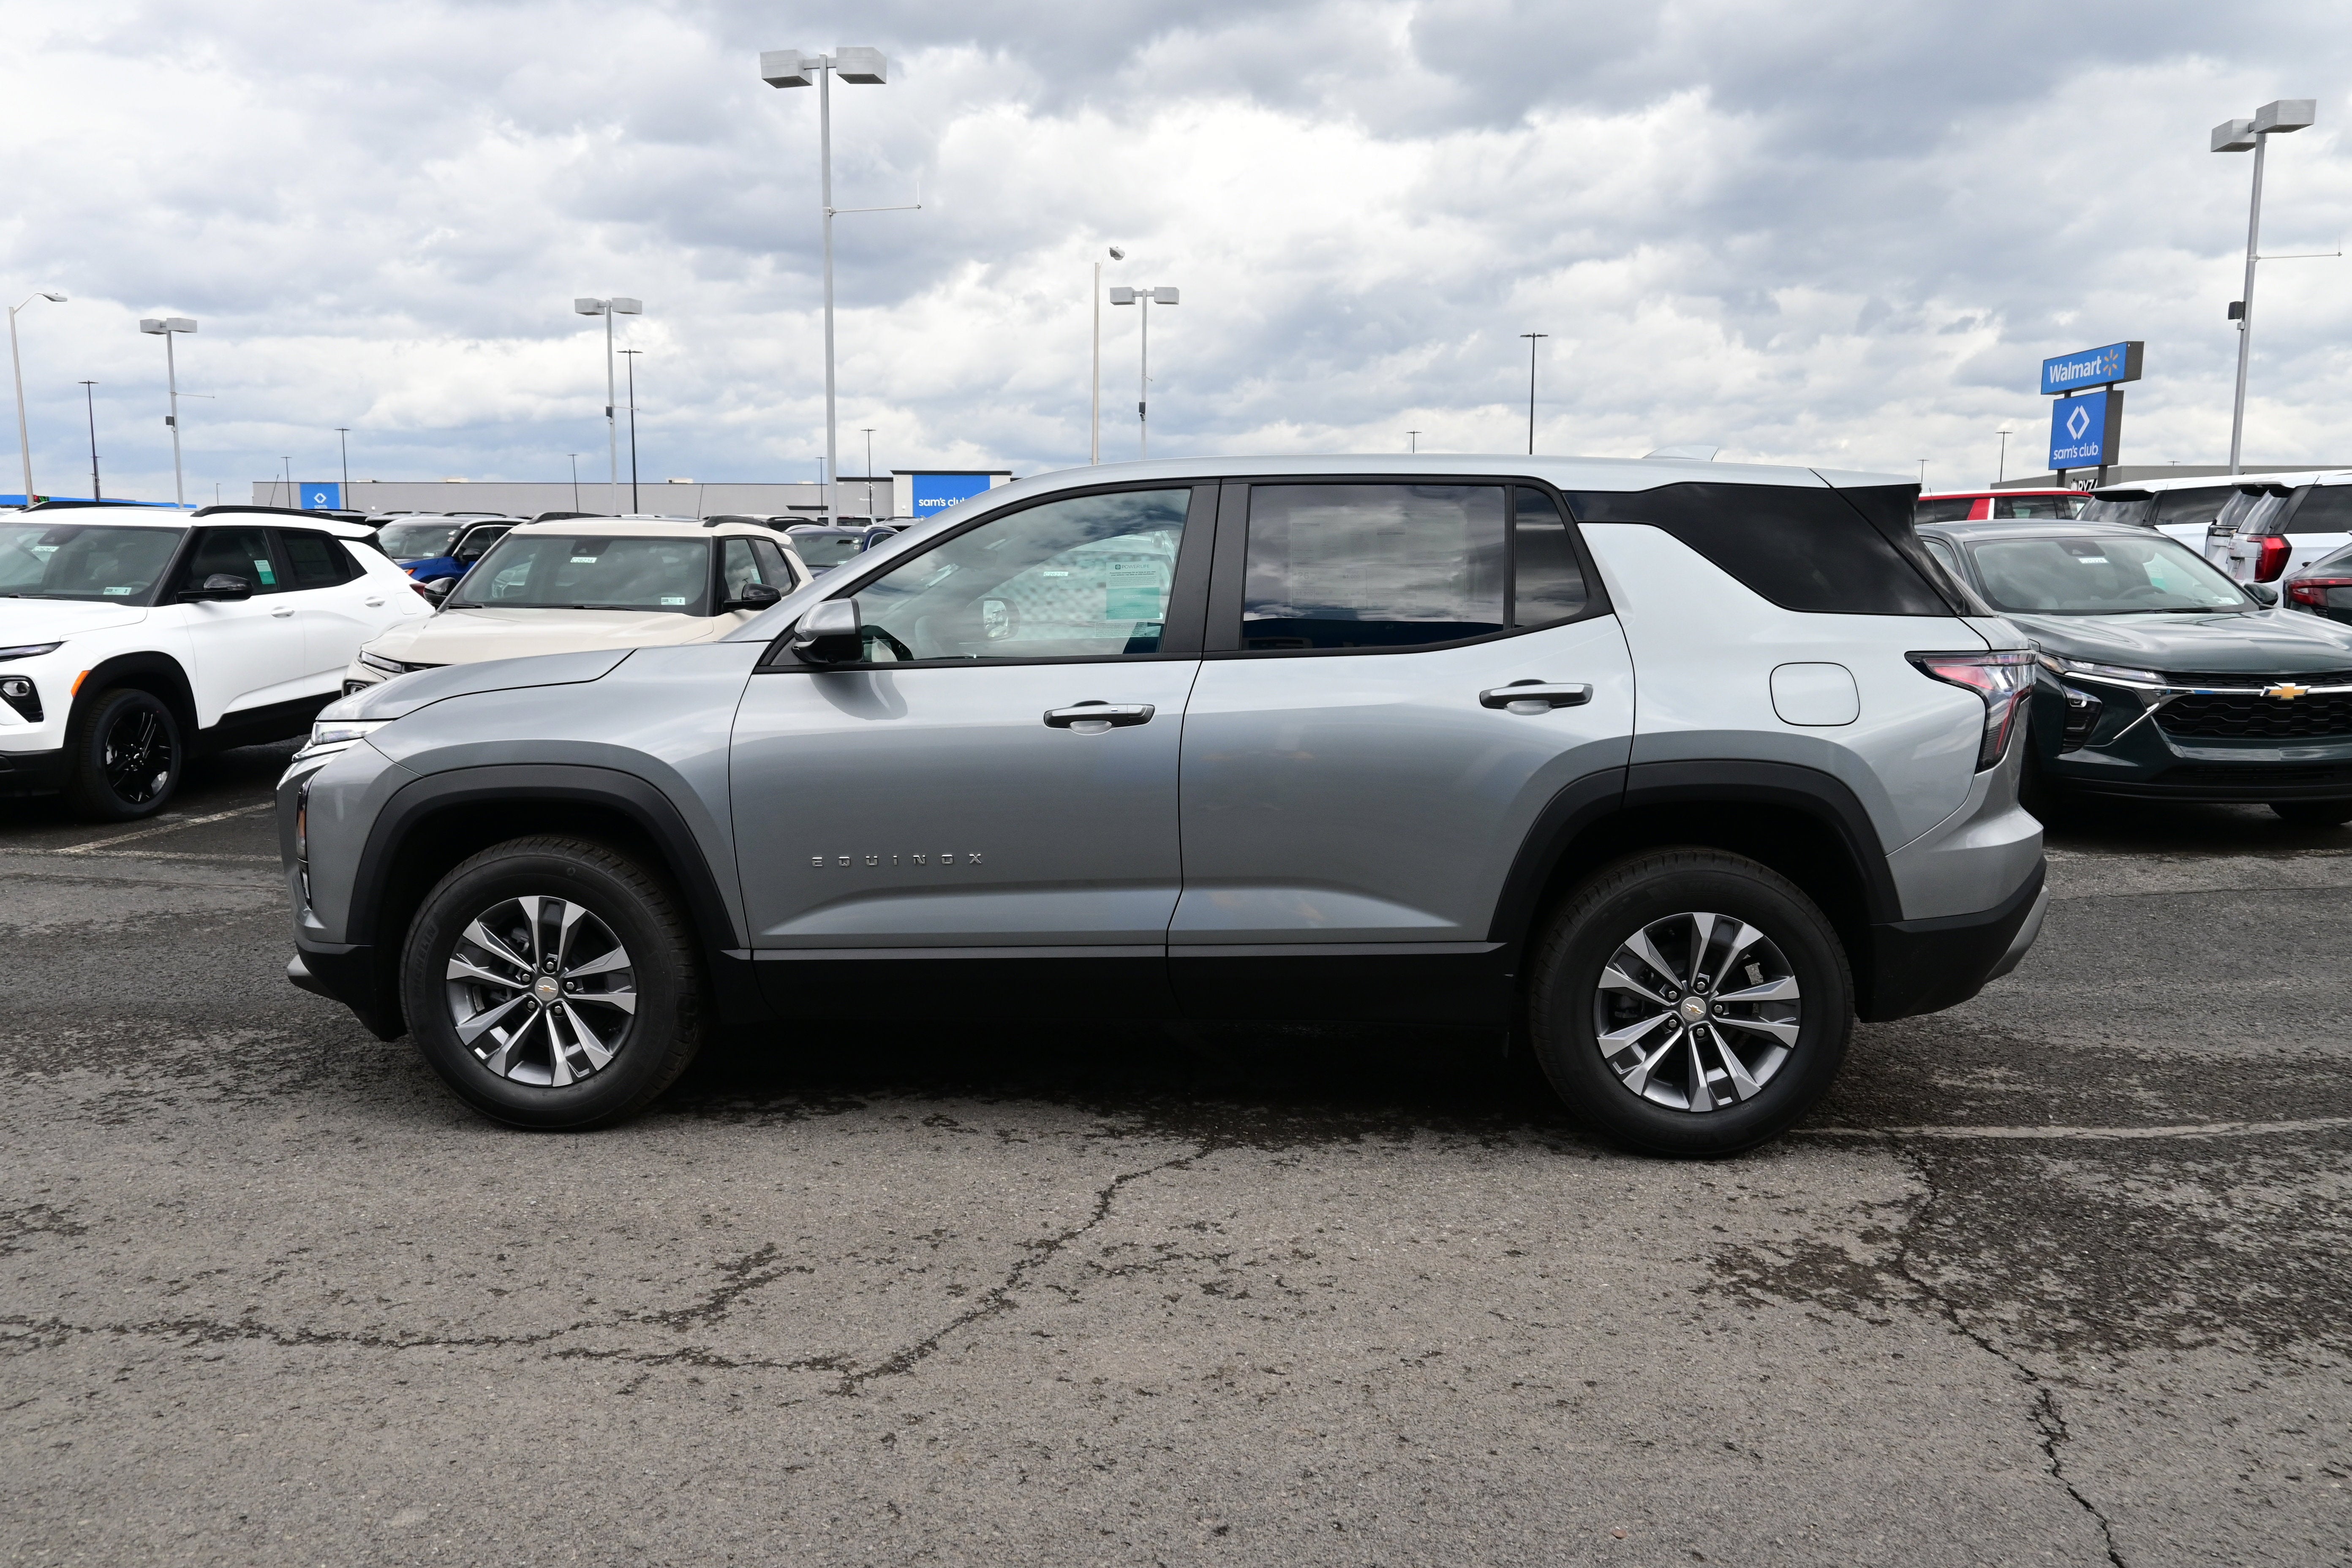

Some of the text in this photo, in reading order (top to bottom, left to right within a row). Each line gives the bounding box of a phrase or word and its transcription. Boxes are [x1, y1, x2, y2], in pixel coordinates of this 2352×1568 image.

[2050, 356, 2102, 384] Walmart
[2053, 441, 2099, 460] sam's club
[918, 497, 946, 507] sam's
[811, 853, 982, 868] EQUINOX
